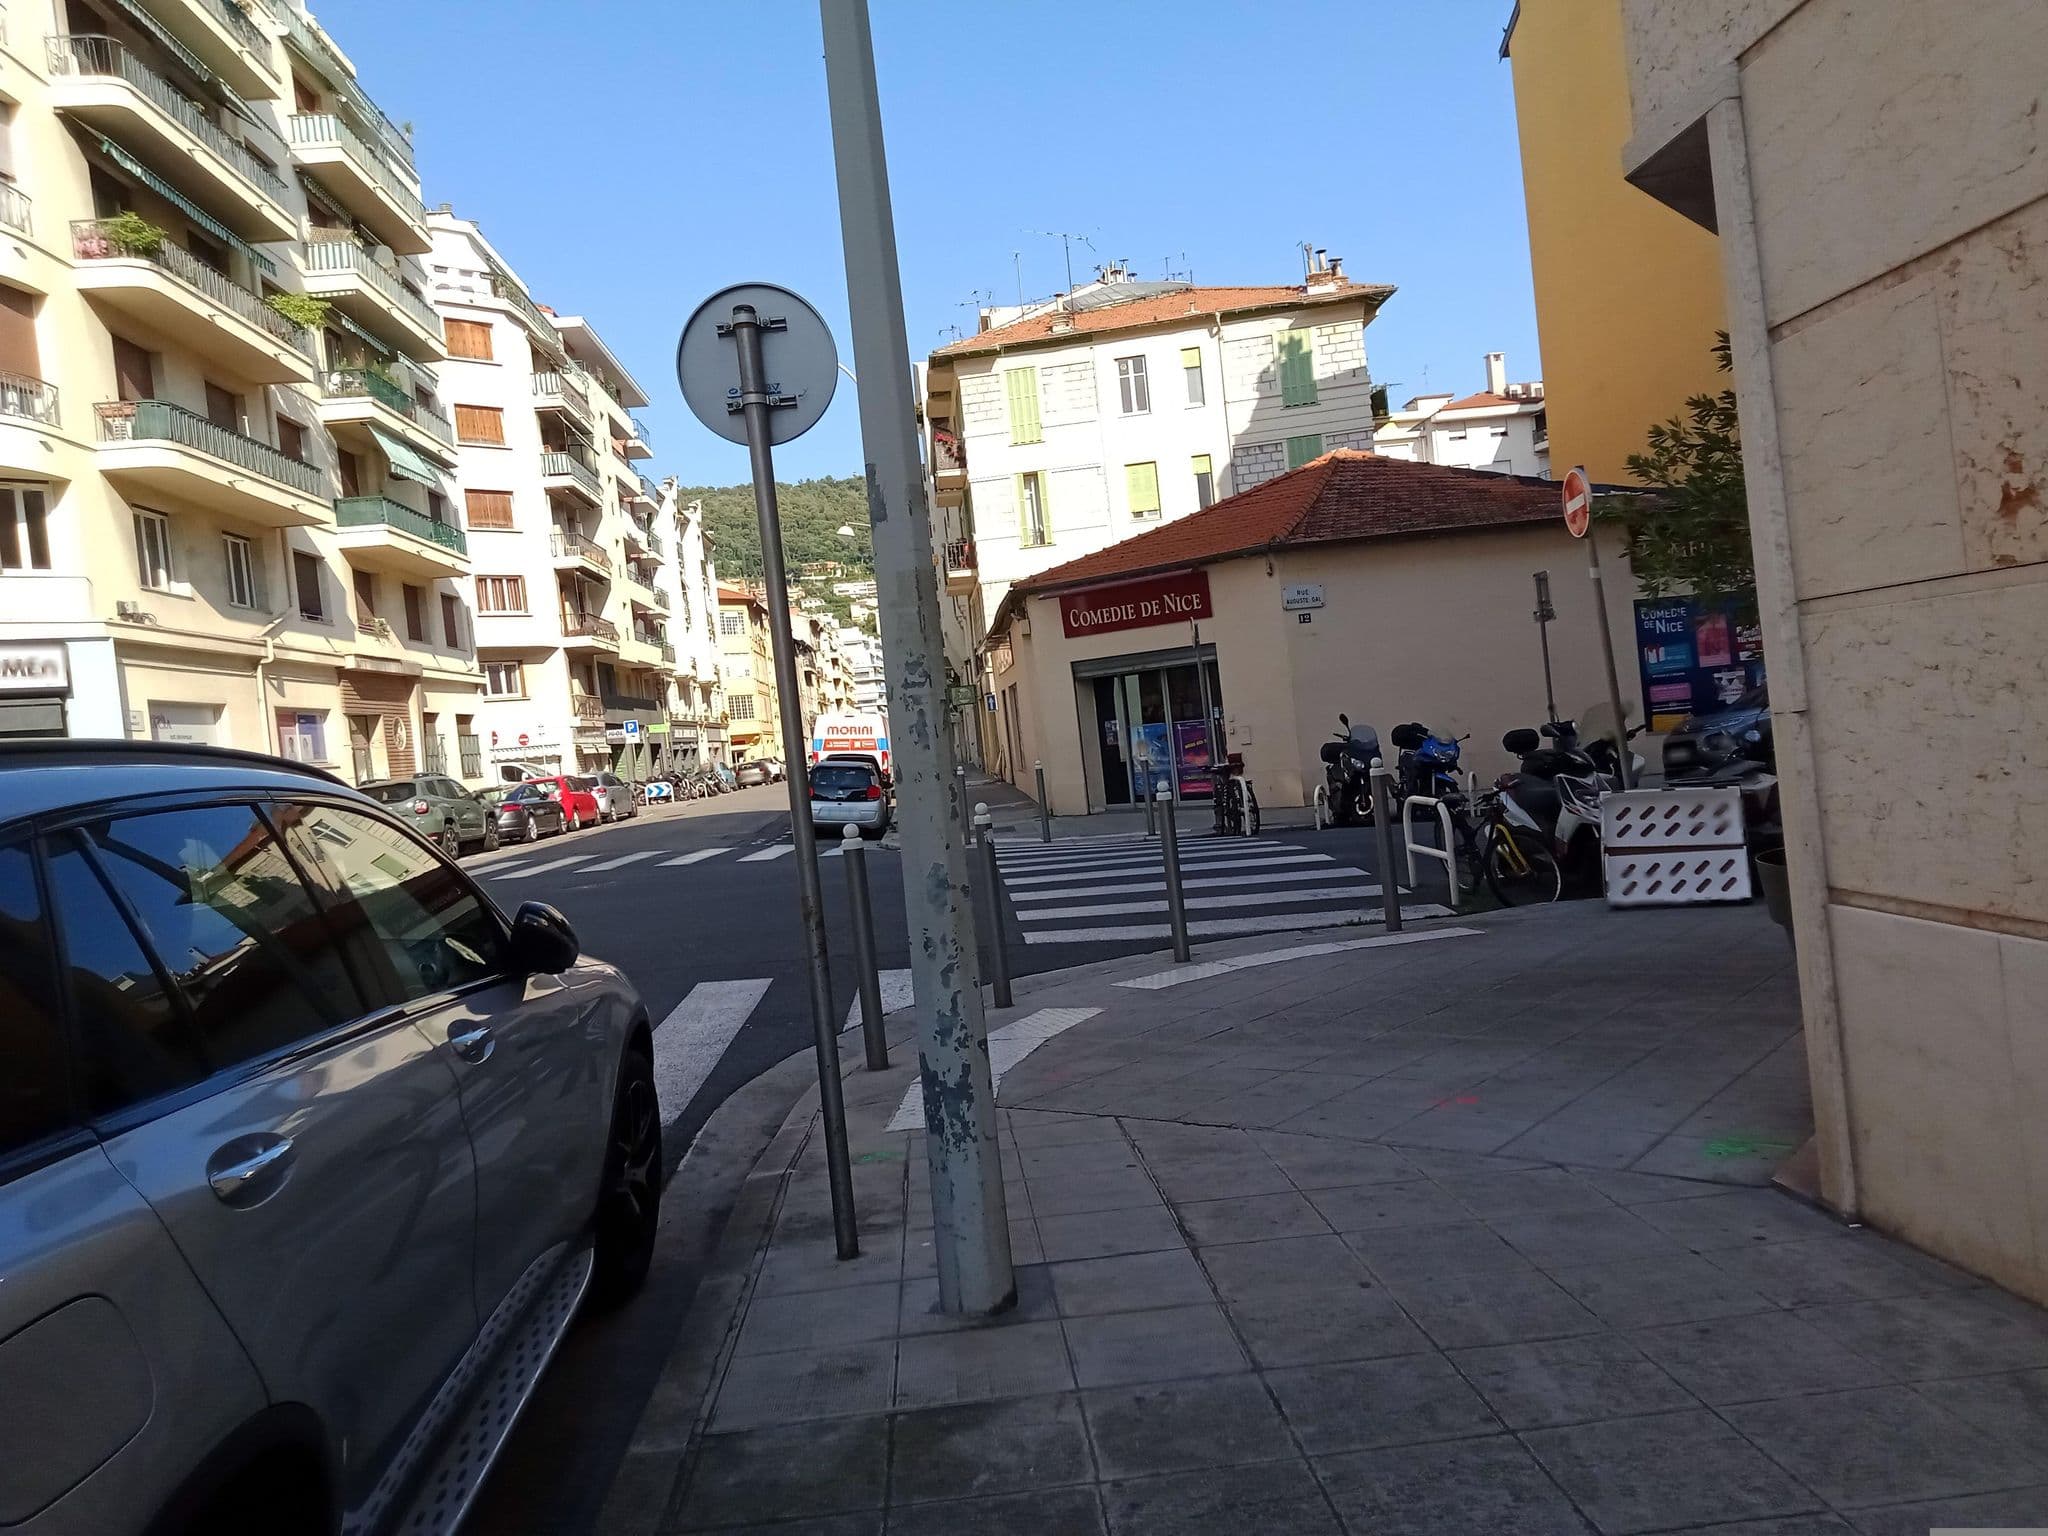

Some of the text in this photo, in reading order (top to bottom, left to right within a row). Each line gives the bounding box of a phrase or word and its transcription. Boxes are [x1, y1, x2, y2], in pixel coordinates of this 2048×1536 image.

[1070, 593, 1202, 628] COMEDIE DE NICE
[1300, 614, 1310, 622] 12
[1643, 619, 1685, 634] DE NICE
[827, 726, 873, 735] MORINI
